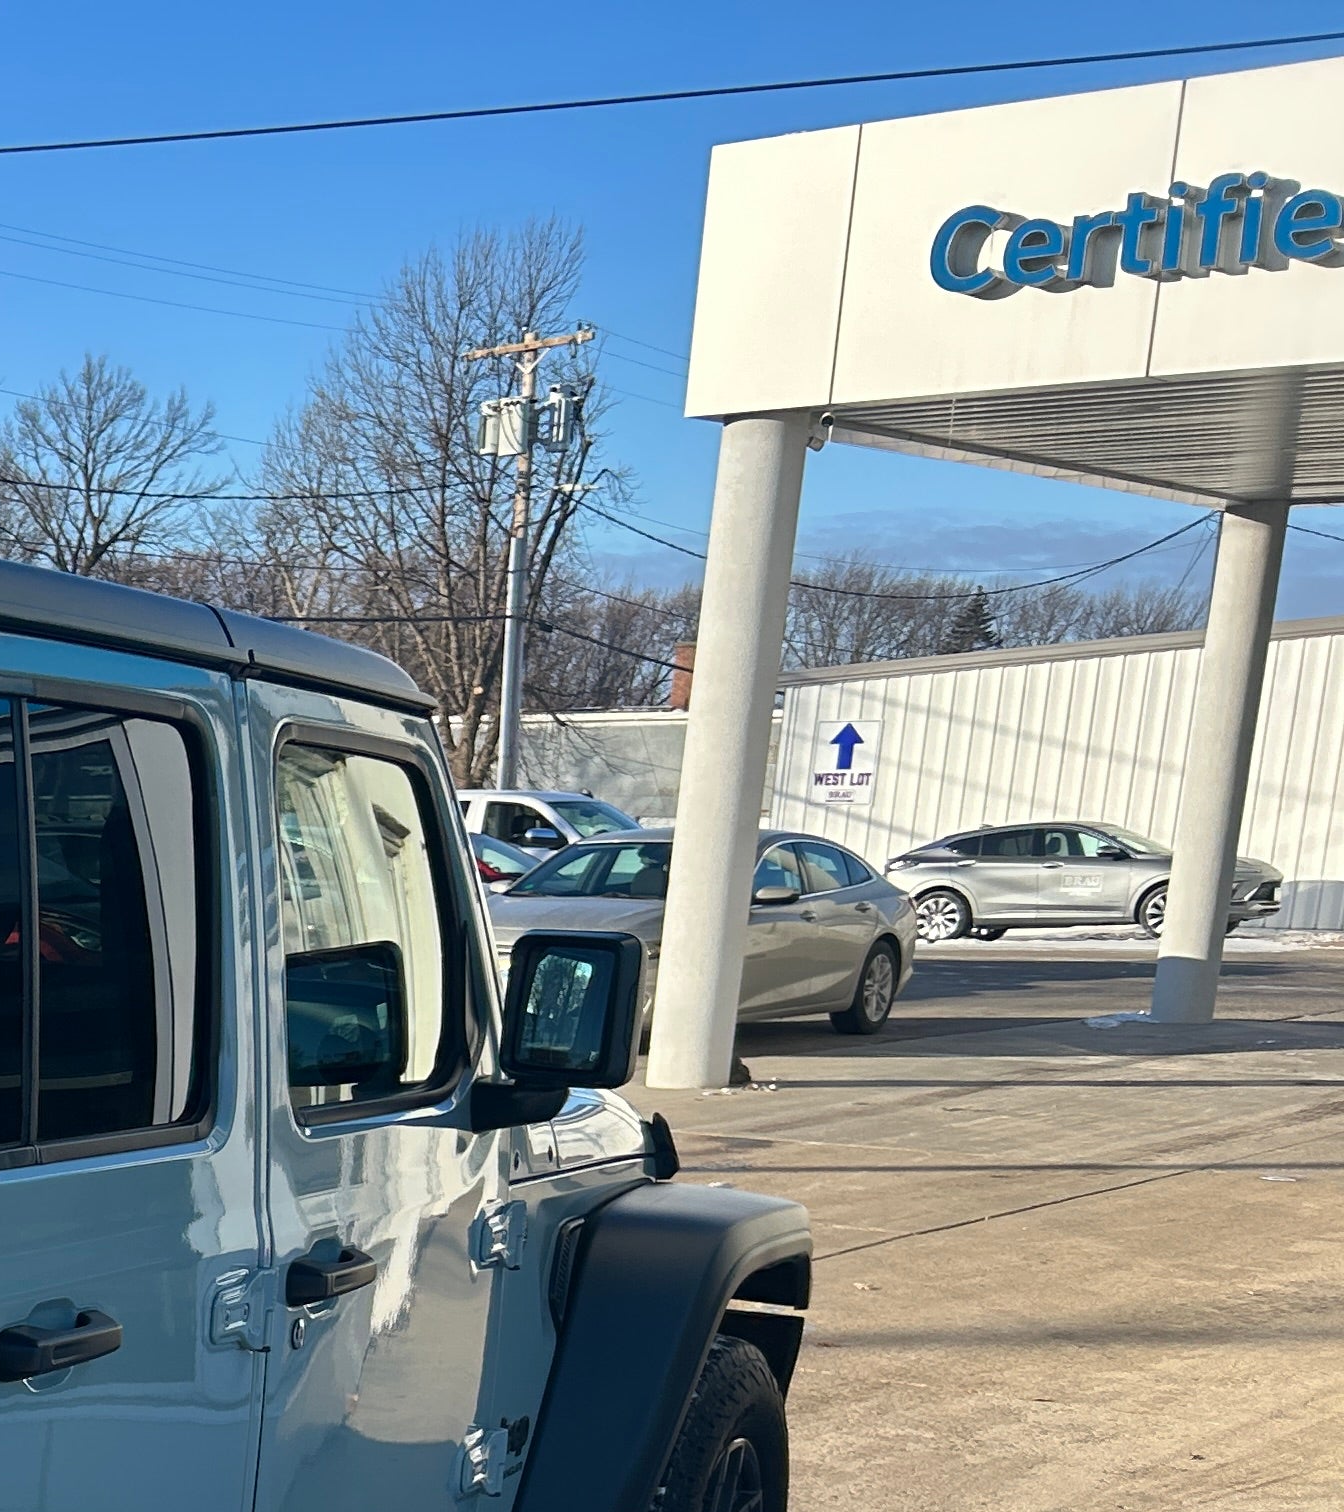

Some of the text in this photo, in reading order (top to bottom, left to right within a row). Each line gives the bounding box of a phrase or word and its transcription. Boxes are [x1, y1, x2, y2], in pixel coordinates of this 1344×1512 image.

[929, 170, 1344, 298] Certifie
[813, 772, 872, 787] WEST LOT
